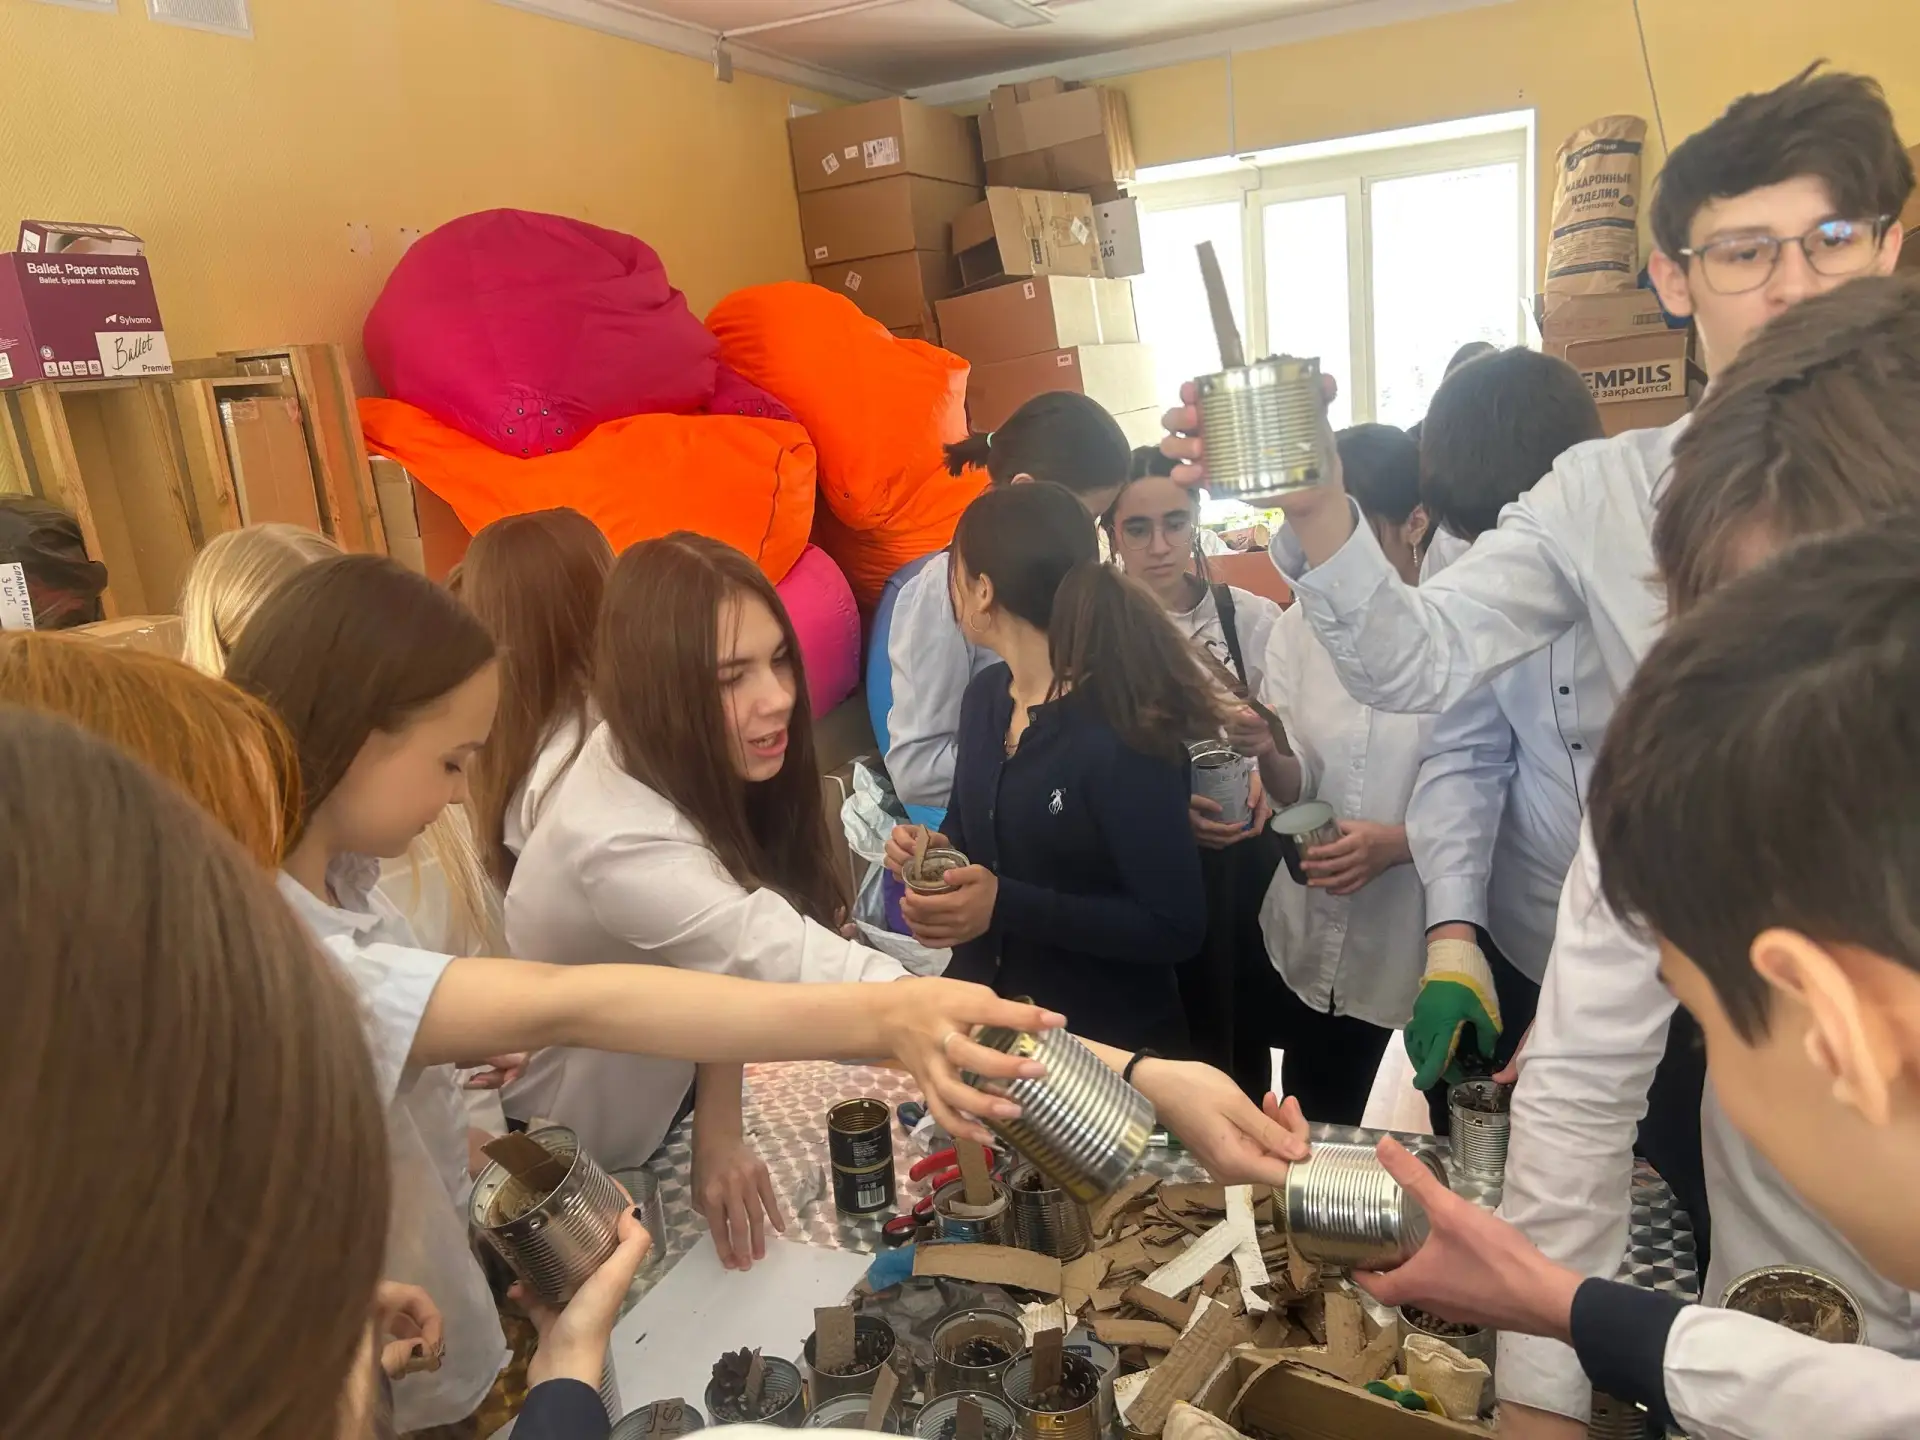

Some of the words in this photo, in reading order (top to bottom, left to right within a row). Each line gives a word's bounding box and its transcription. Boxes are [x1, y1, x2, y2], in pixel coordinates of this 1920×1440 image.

[1571, 188, 1620, 206] ИЗДЕЛИЯ
[26, 262, 64, 275] Ballet.
[65, 263, 98, 277] Paper
[99, 264, 140, 276] matters
[61, 277, 86, 286] Бумага
[112, 334, 154, 371] Ballet
[142, 364, 172, 373] Premier
[1601, 381, 1672, 399] закрасится!
[20, 599, 33, 629] МЕШК
